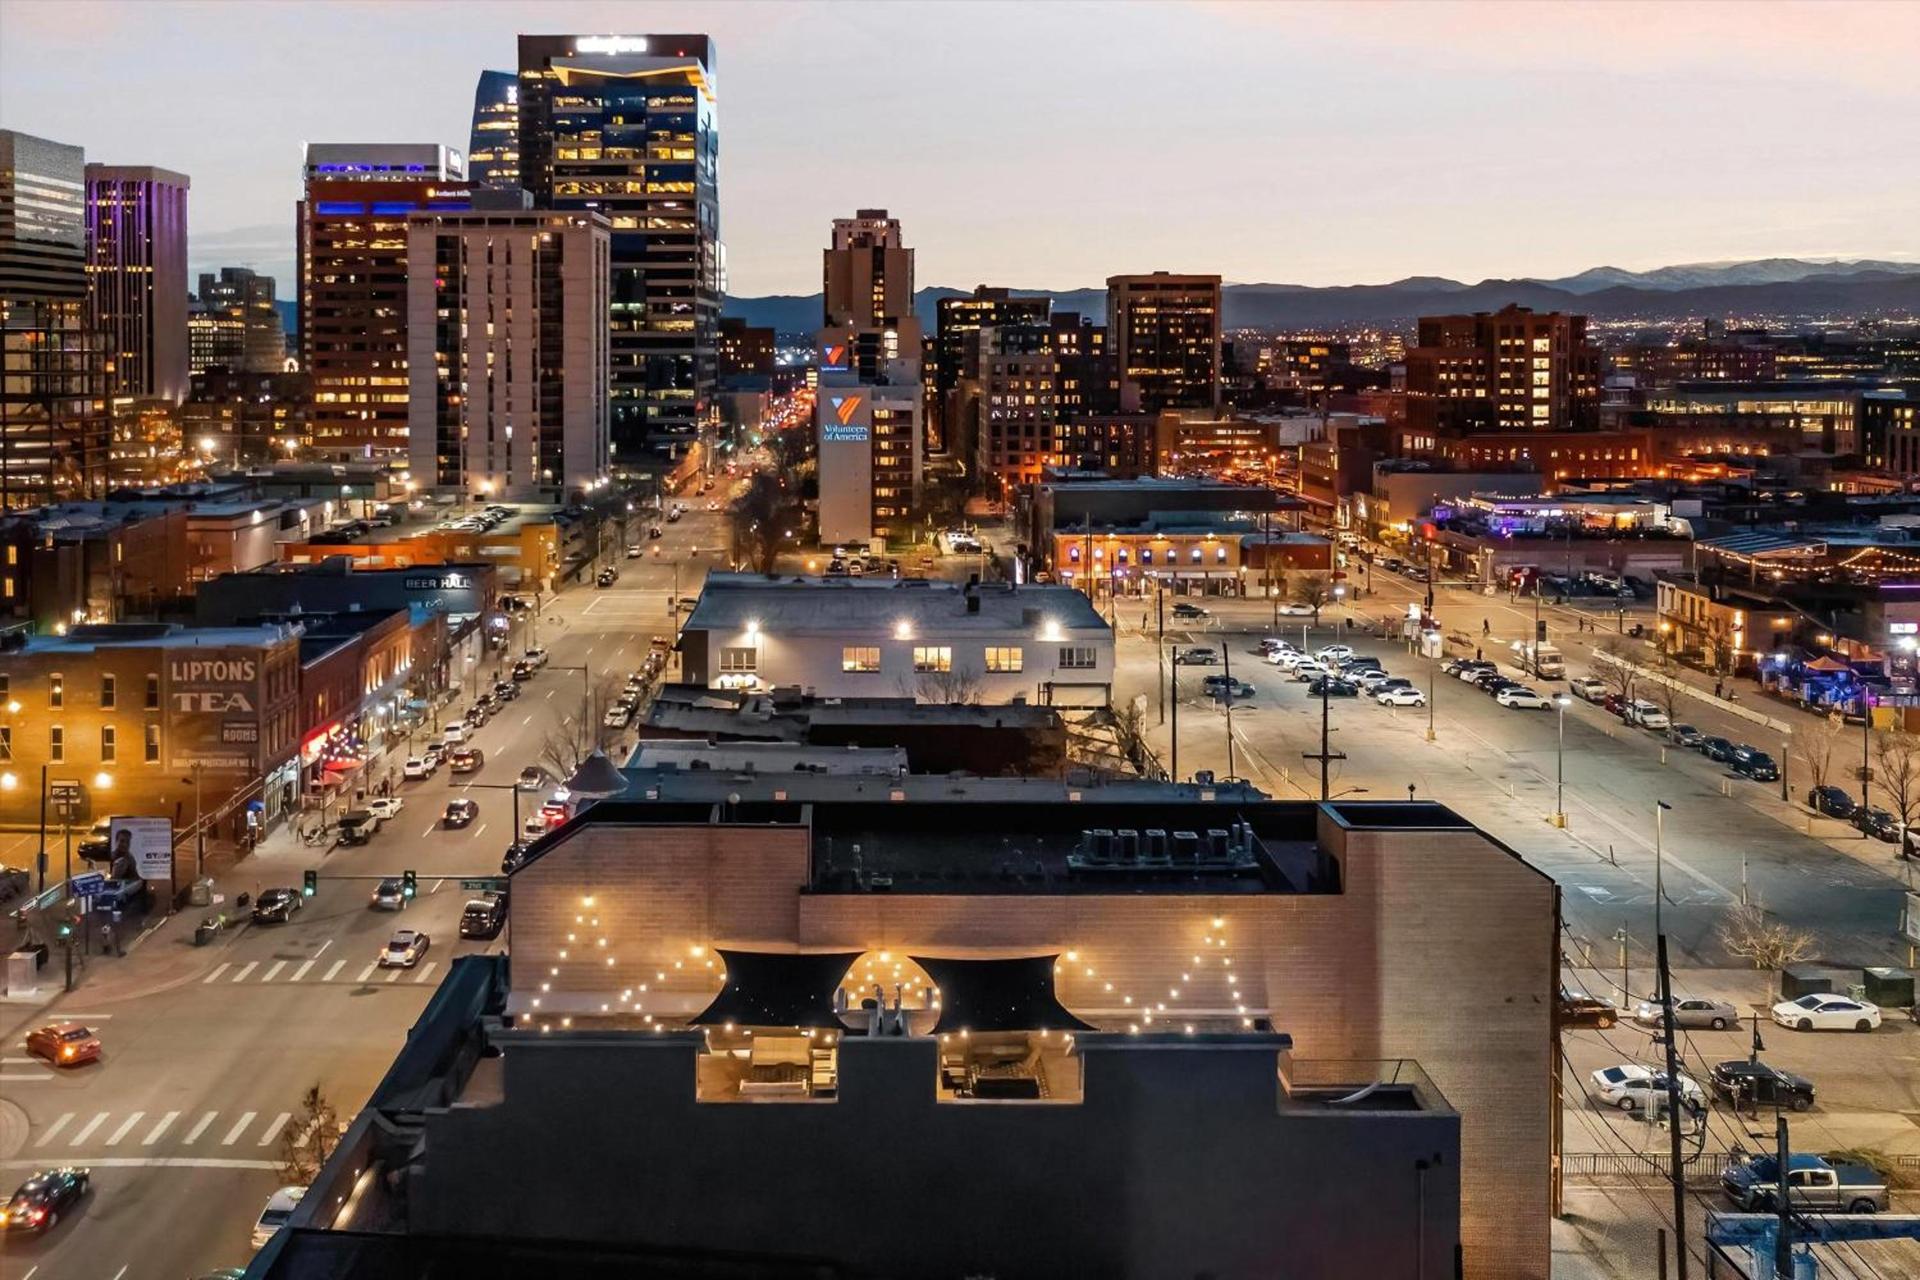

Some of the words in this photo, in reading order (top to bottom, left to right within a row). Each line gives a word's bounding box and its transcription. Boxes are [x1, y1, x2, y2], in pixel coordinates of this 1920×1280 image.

[824, 425, 867, 433] Volunteers
[824, 433, 834, 441] of
[834, 433, 867, 441] America
[406, 579, 436, 588] BEER
[171, 657, 256, 681] LIPTON'S
[172, 692, 254, 712] TEA
[223, 729, 257, 742] ROOMS
